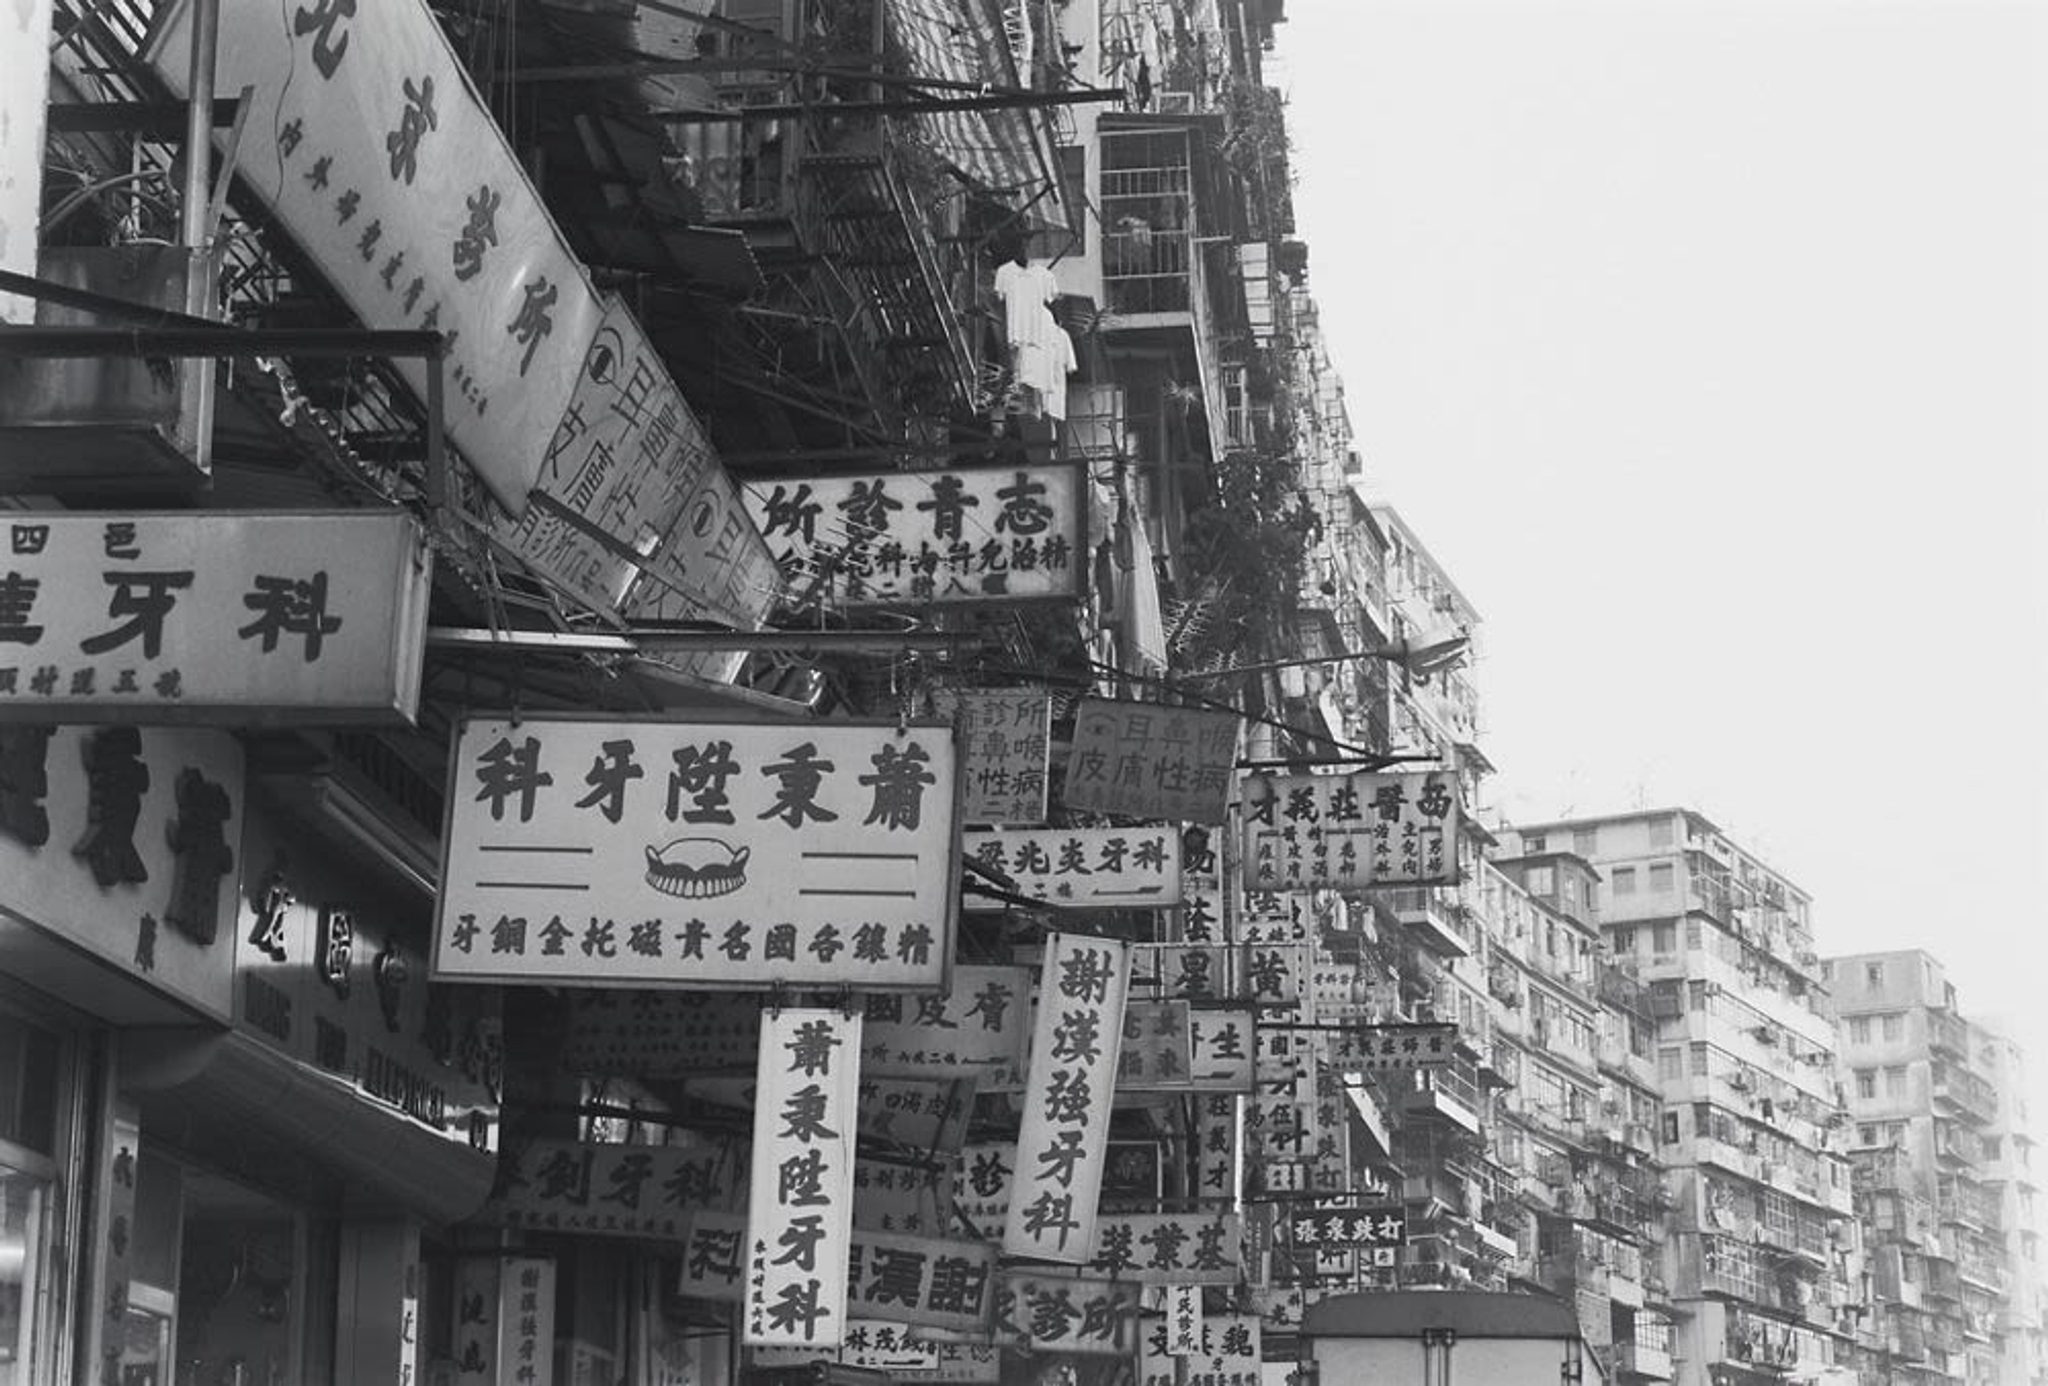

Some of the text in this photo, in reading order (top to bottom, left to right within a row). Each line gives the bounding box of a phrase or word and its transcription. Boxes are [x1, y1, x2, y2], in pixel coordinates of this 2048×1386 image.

[11, 522, 141, 560] 四邑
[475, 737, 936, 831] 蕭秉陞牙科
[767, 1019, 841, 1341] 蕭秉陞牙科
[1023, 948, 1115, 1252] 謝漢強牙科
